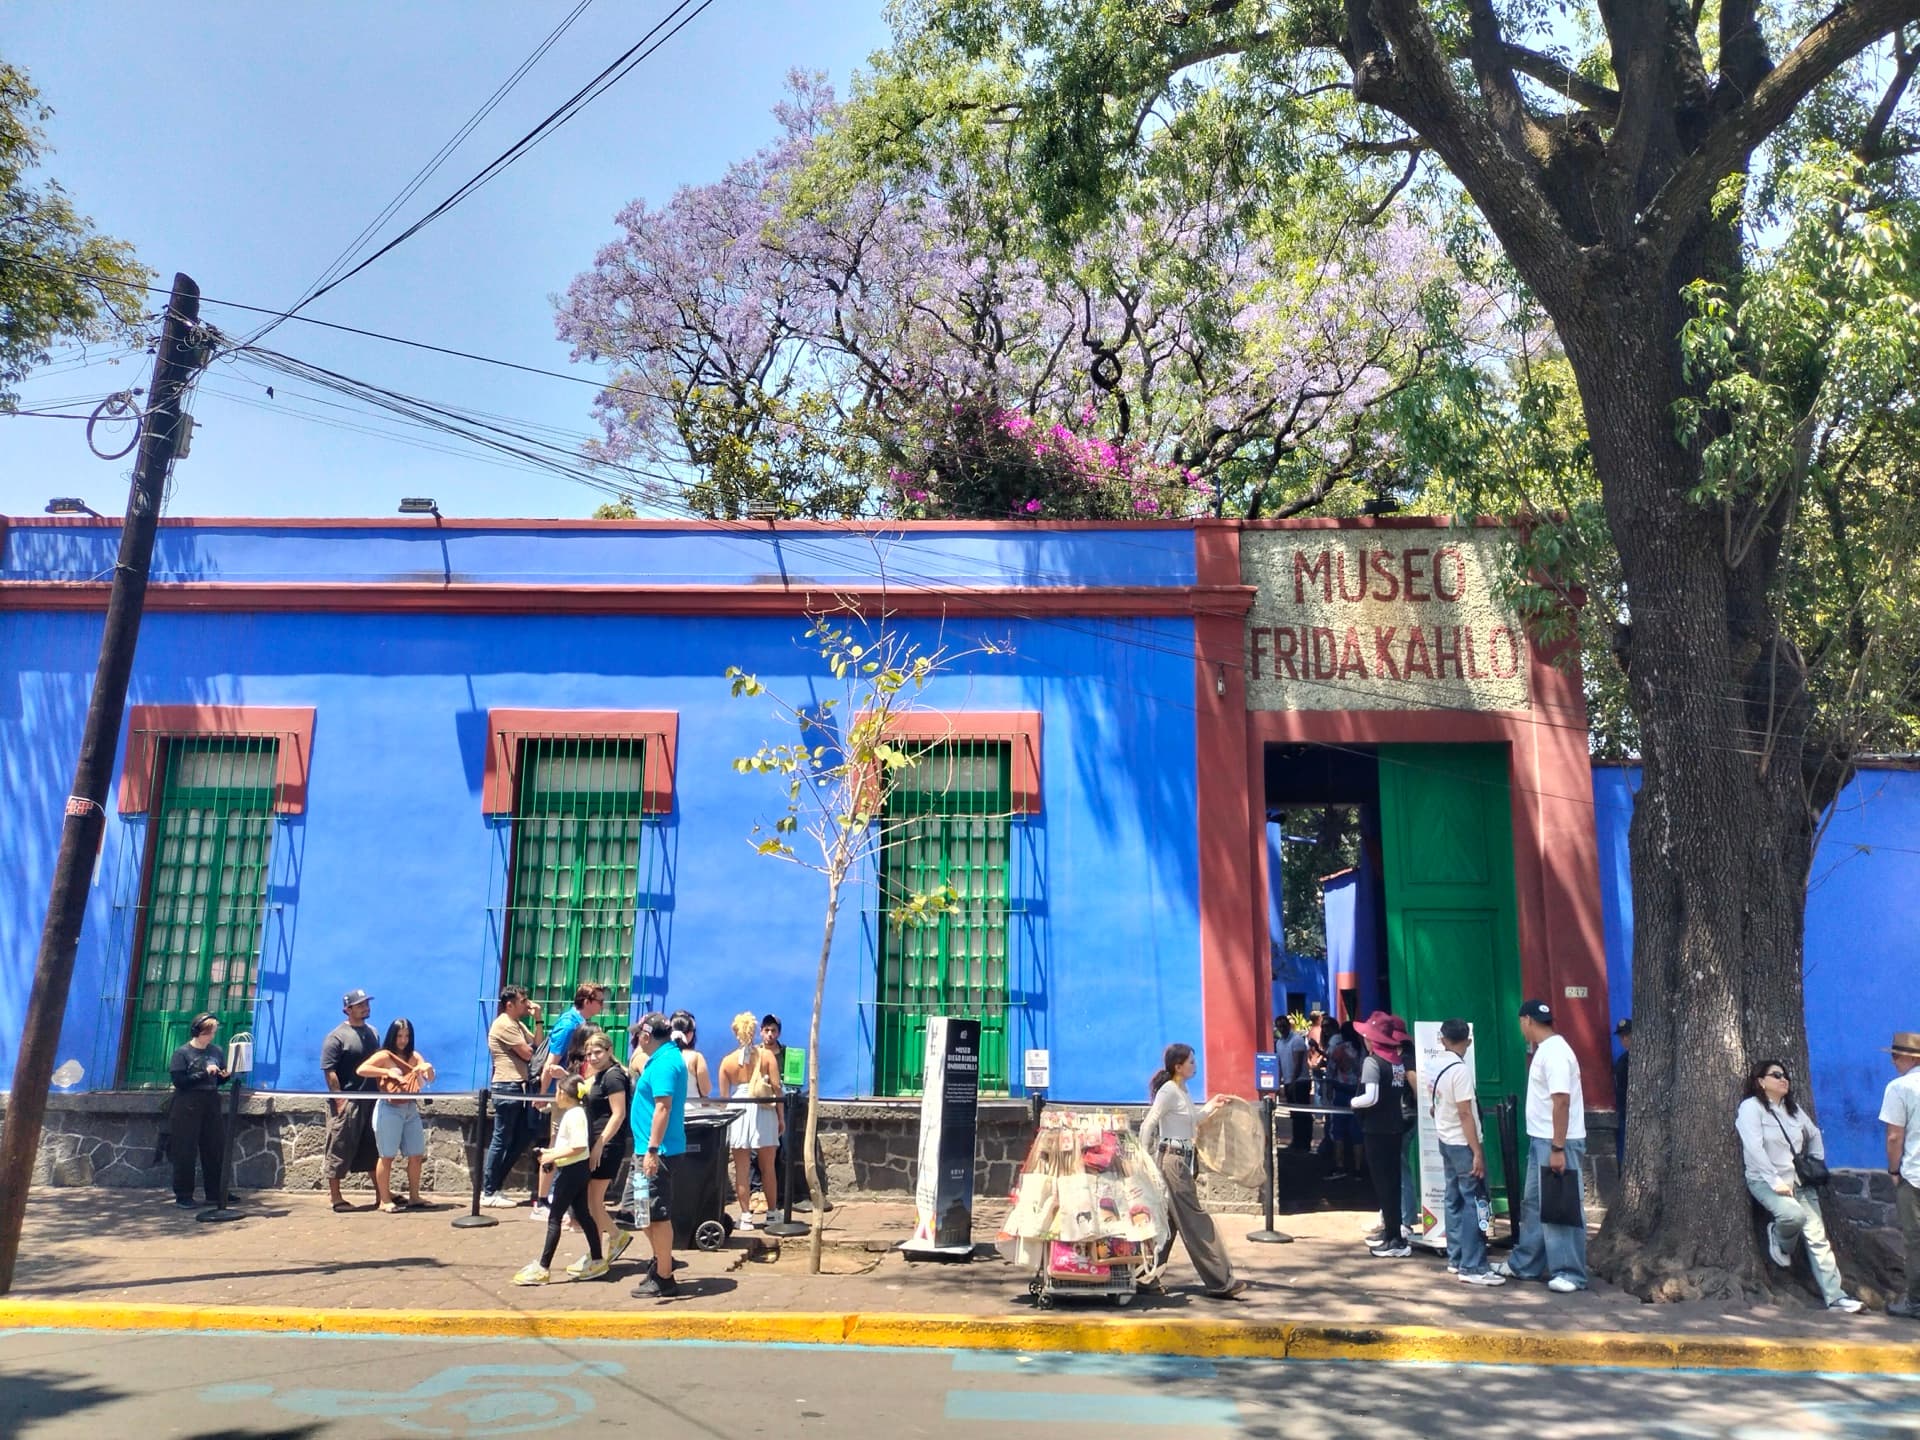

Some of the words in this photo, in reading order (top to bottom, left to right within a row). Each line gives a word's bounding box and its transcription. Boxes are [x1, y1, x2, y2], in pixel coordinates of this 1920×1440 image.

[1294, 548, 1466, 603] MUSEO
[1250, 626, 1369, 681] FRIDA
[1375, 624, 1519, 681] KAHLO
